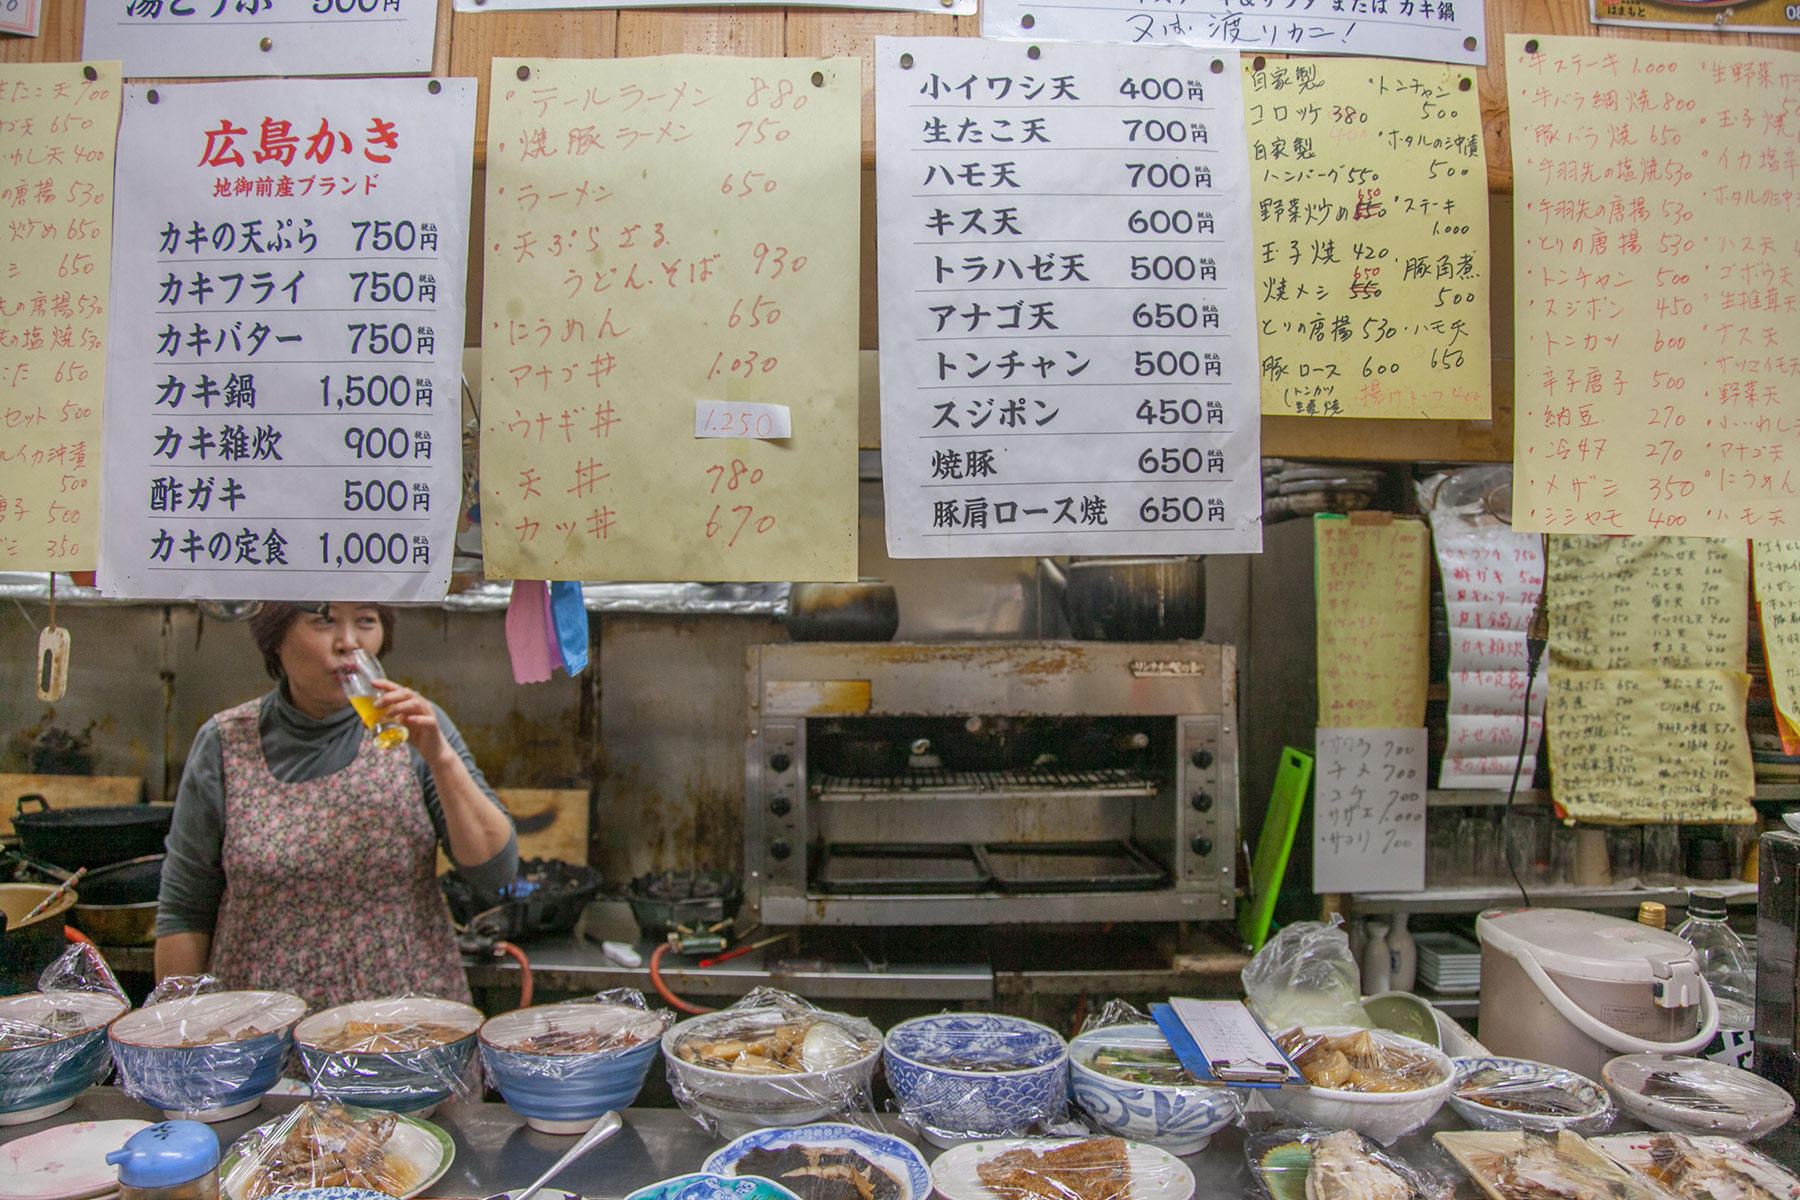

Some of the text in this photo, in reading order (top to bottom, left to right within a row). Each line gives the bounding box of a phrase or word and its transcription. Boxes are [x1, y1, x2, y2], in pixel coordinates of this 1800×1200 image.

[1400, 2, 1455, 21] カキ鍋
[1528, 53, 1618, 76] 牛ステーキ
[532, 77, 808, 118] テールラーメン 880
[919, 73, 1081, 101] 小イワシ天
[1378, 75, 1450, 99] トンチャン
[1250, 102, 1368, 125] コロッケ 380
[1421, 101, 1458, 120] 500
[1664, 92, 1695, 112] 800
[50, 113, 93, 133] 650
[922, 116, 1051, 144] 生たこ天
[1535, 123, 1681, 149] 豚バラ焼 650
[199, 115, 401, 168] 広島かき
[520, 117, 791, 162] 焼豚ラーメン 750
[1254, 137, 1317, 161] 自家製
[74, 144, 104, 164] 400
[923, 160, 1021, 189] ハモ天
[1264, 164, 1379, 185] ハンバーグ 550
[1428, 159, 1468, 180] 500
[1665, 160, 1692, 187] 530
[68, 181, 104, 207] 530
[212, 173, 380, 198] 地御前産ブランド
[517, 171, 777, 212] ラーメン 650
[1357, 188, 1381, 201] 650
[1259, 198, 1349, 226] 野菜炒め
[1404, 199, 1456, 215] ステーキ
[1662, 199, 1693, 225] 530
[67, 219, 100, 240] 650
[925, 207, 1023, 236] キス天
[157, 219, 320, 255] カキの天ぷら
[1658, 232, 1694, 256] 530
[754, 242, 807, 279] 930
[1262, 240, 1388, 265] 玉子焼 420
[1403, 249, 1480, 281] 豚角煮
[58, 254, 94, 278] 650
[935, 253, 1090, 284] トラハゼ天
[1353, 266, 1380, 280] 650
[1543, 267, 1690, 288] トンチャン 500
[156, 271, 306, 306] カキフライ
[1263, 276, 1329, 303] 焼メシ
[1434, 287, 1474, 307] 500
[728, 295, 782, 328] 650
[928, 301, 1060, 332] アナゴ天
[1656, 297, 1692, 318] 450
[155, 322, 303, 357] カキバター
[1262, 313, 1397, 342] とりの唐揚 530
[1546, 329, 1686, 356] トンカツ 600
[936, 349, 1090, 381] トンチャン
[1262, 356, 1399, 382] 豚ロース 600
[1430, 348, 1464, 369] 650
[54, 361, 89, 383] 650
[1652, 370, 1685, 389] 500
[154, 373, 256, 409] カキ鍋
[60, 400, 91, 422] 500
[509, 400, 622, 442] ウナギ丼
[931, 397, 1060, 429] スジポン
[1544, 404, 1685, 428] 納豆 270
[152, 424, 283, 463] カキ雑炊
[1646, 440, 1683, 465] 270
[930, 448, 998, 480] 焼豚
[60, 475, 88, 492] 500
[518, 457, 764, 501] 天丼 780
[1649, 474, 1695, 500] 350
[150, 476, 247, 513] 酢ガキ
[48, 500, 81, 524] 500
[932, 495, 1108, 530] 豚肩ロース焼
[1648, 507, 1687, 529] 400
[515, 505, 776, 547] カツ丼 670
[47, 535, 79, 558] 350
[149, 527, 289, 566] カキの定食
